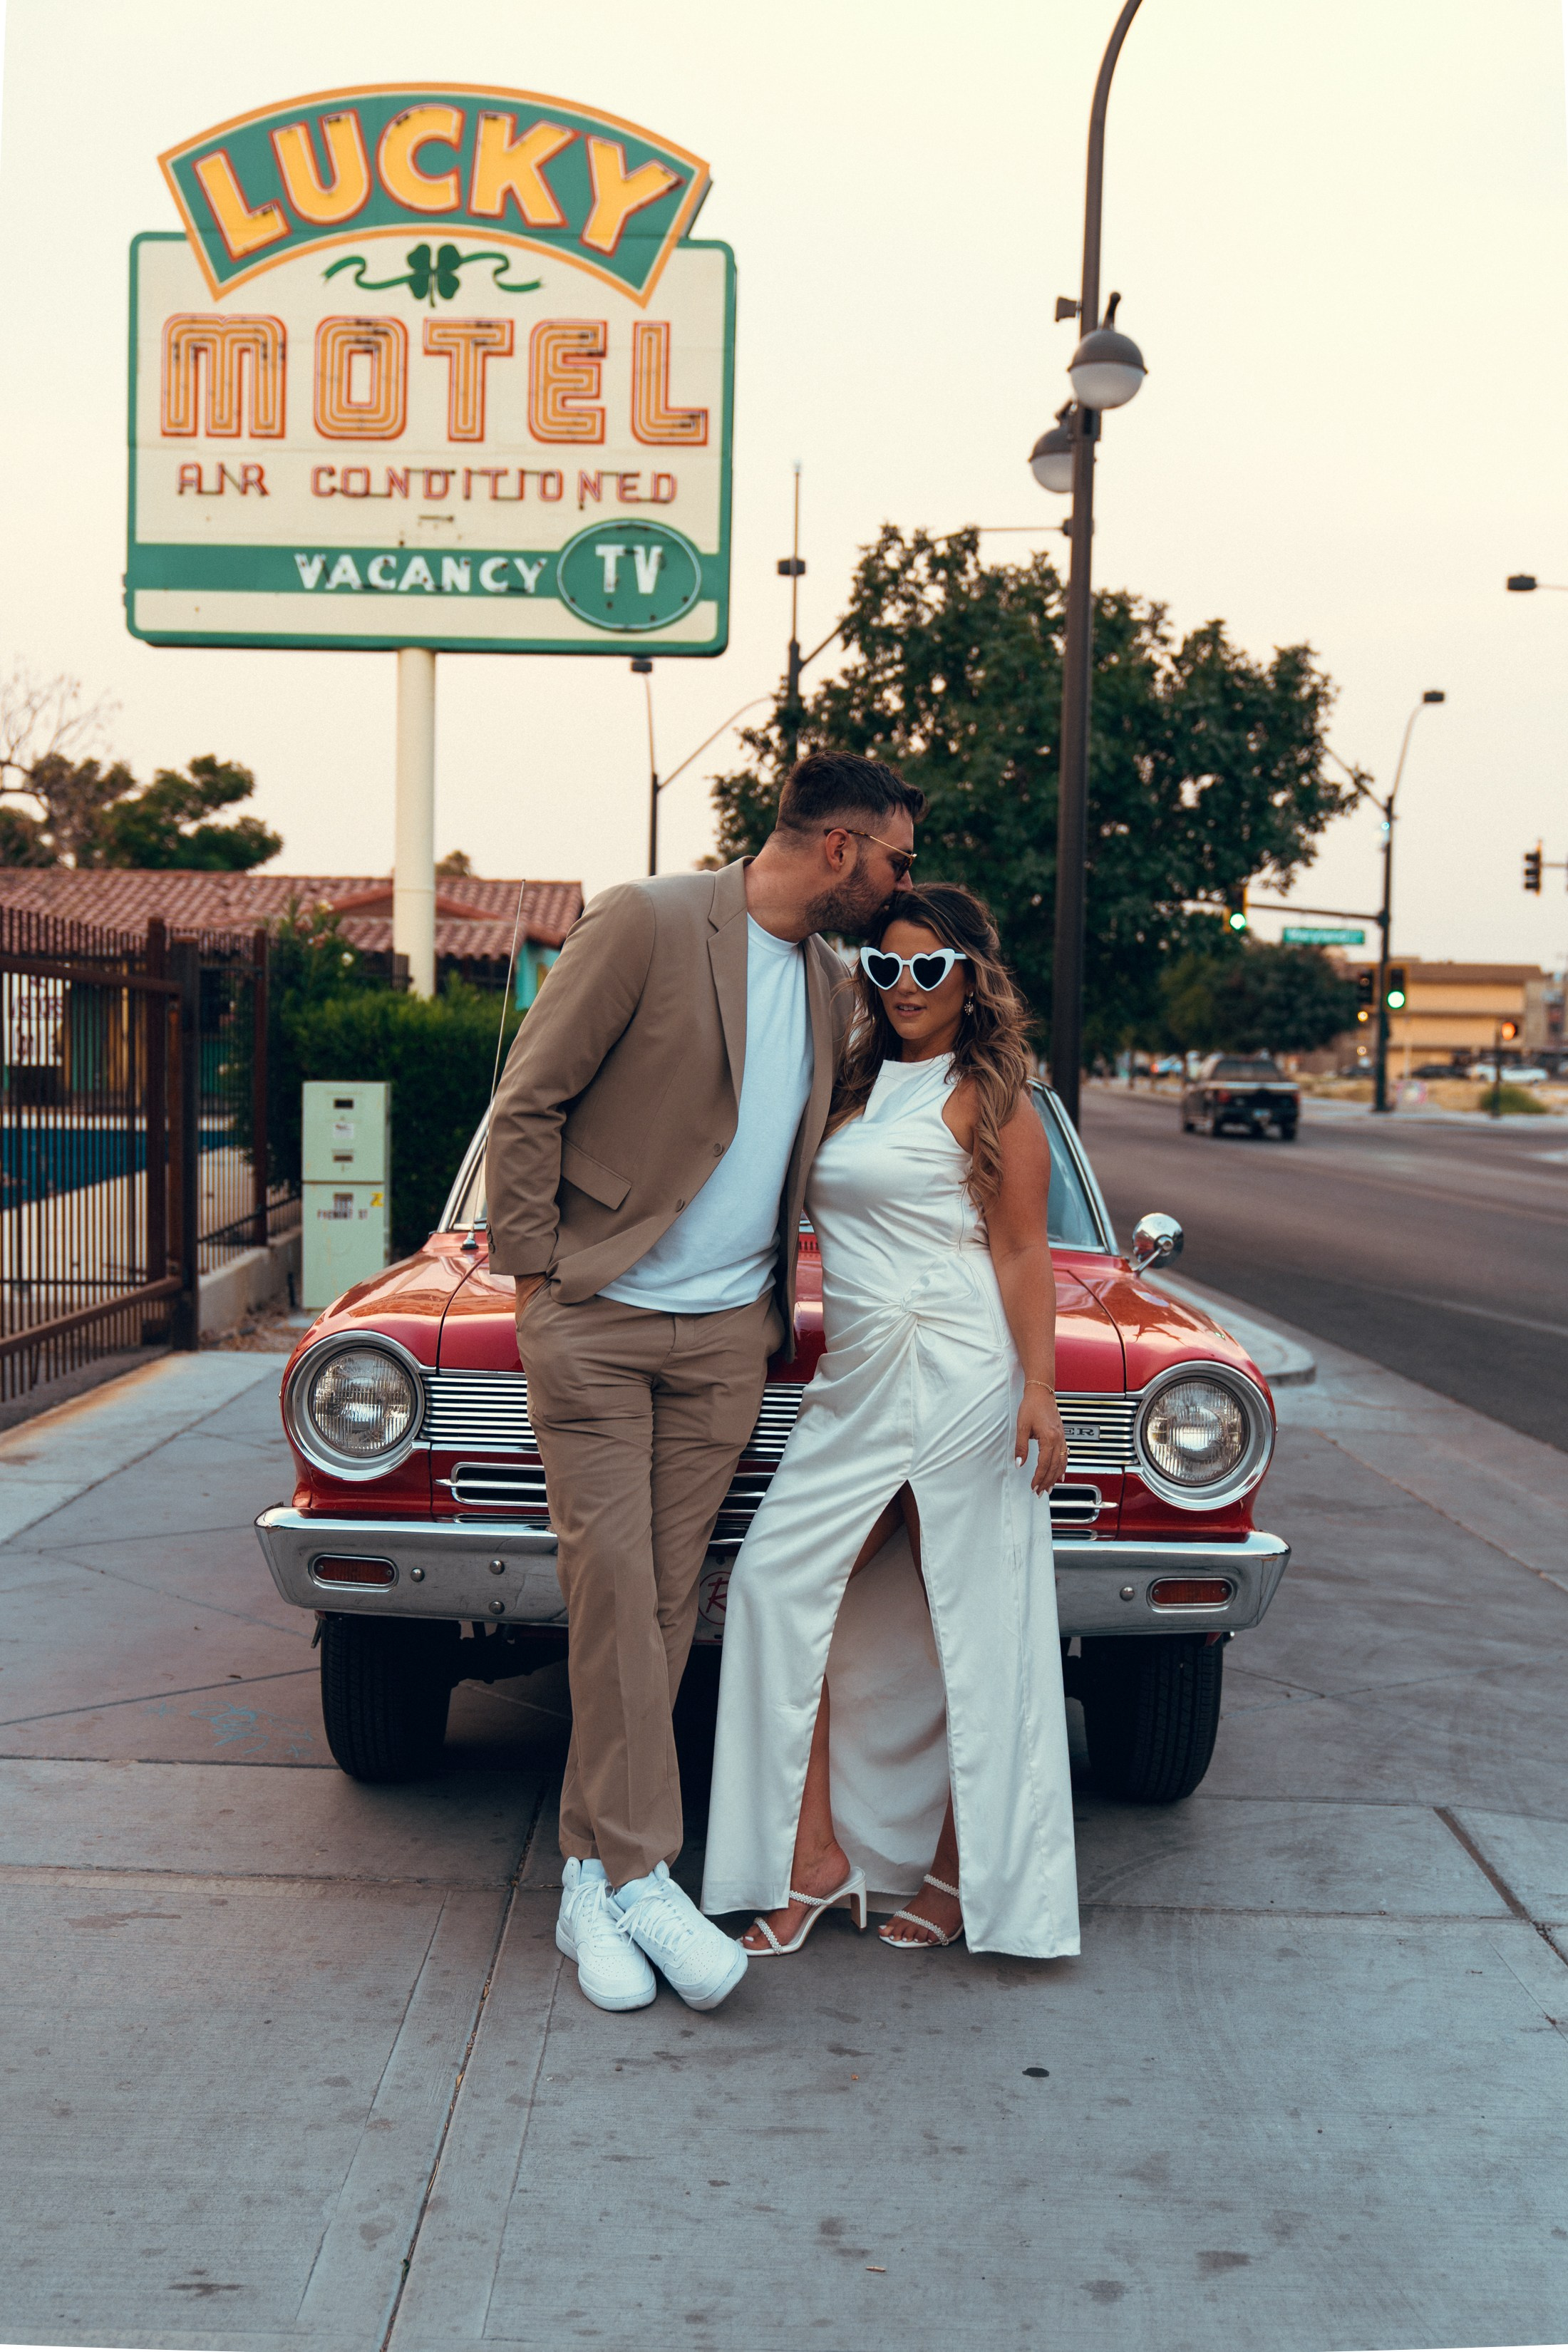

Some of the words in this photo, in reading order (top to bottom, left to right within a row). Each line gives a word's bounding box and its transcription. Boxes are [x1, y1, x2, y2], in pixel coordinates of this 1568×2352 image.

[192, 103, 686, 263] LUCKY
[161, 313, 709, 446] MOTEL
[177, 462, 269, 496] AIR
[311, 464, 677, 503] CONDITIONED
[294, 553, 547, 593] VACANCY
[595, 545, 664, 594] TV
